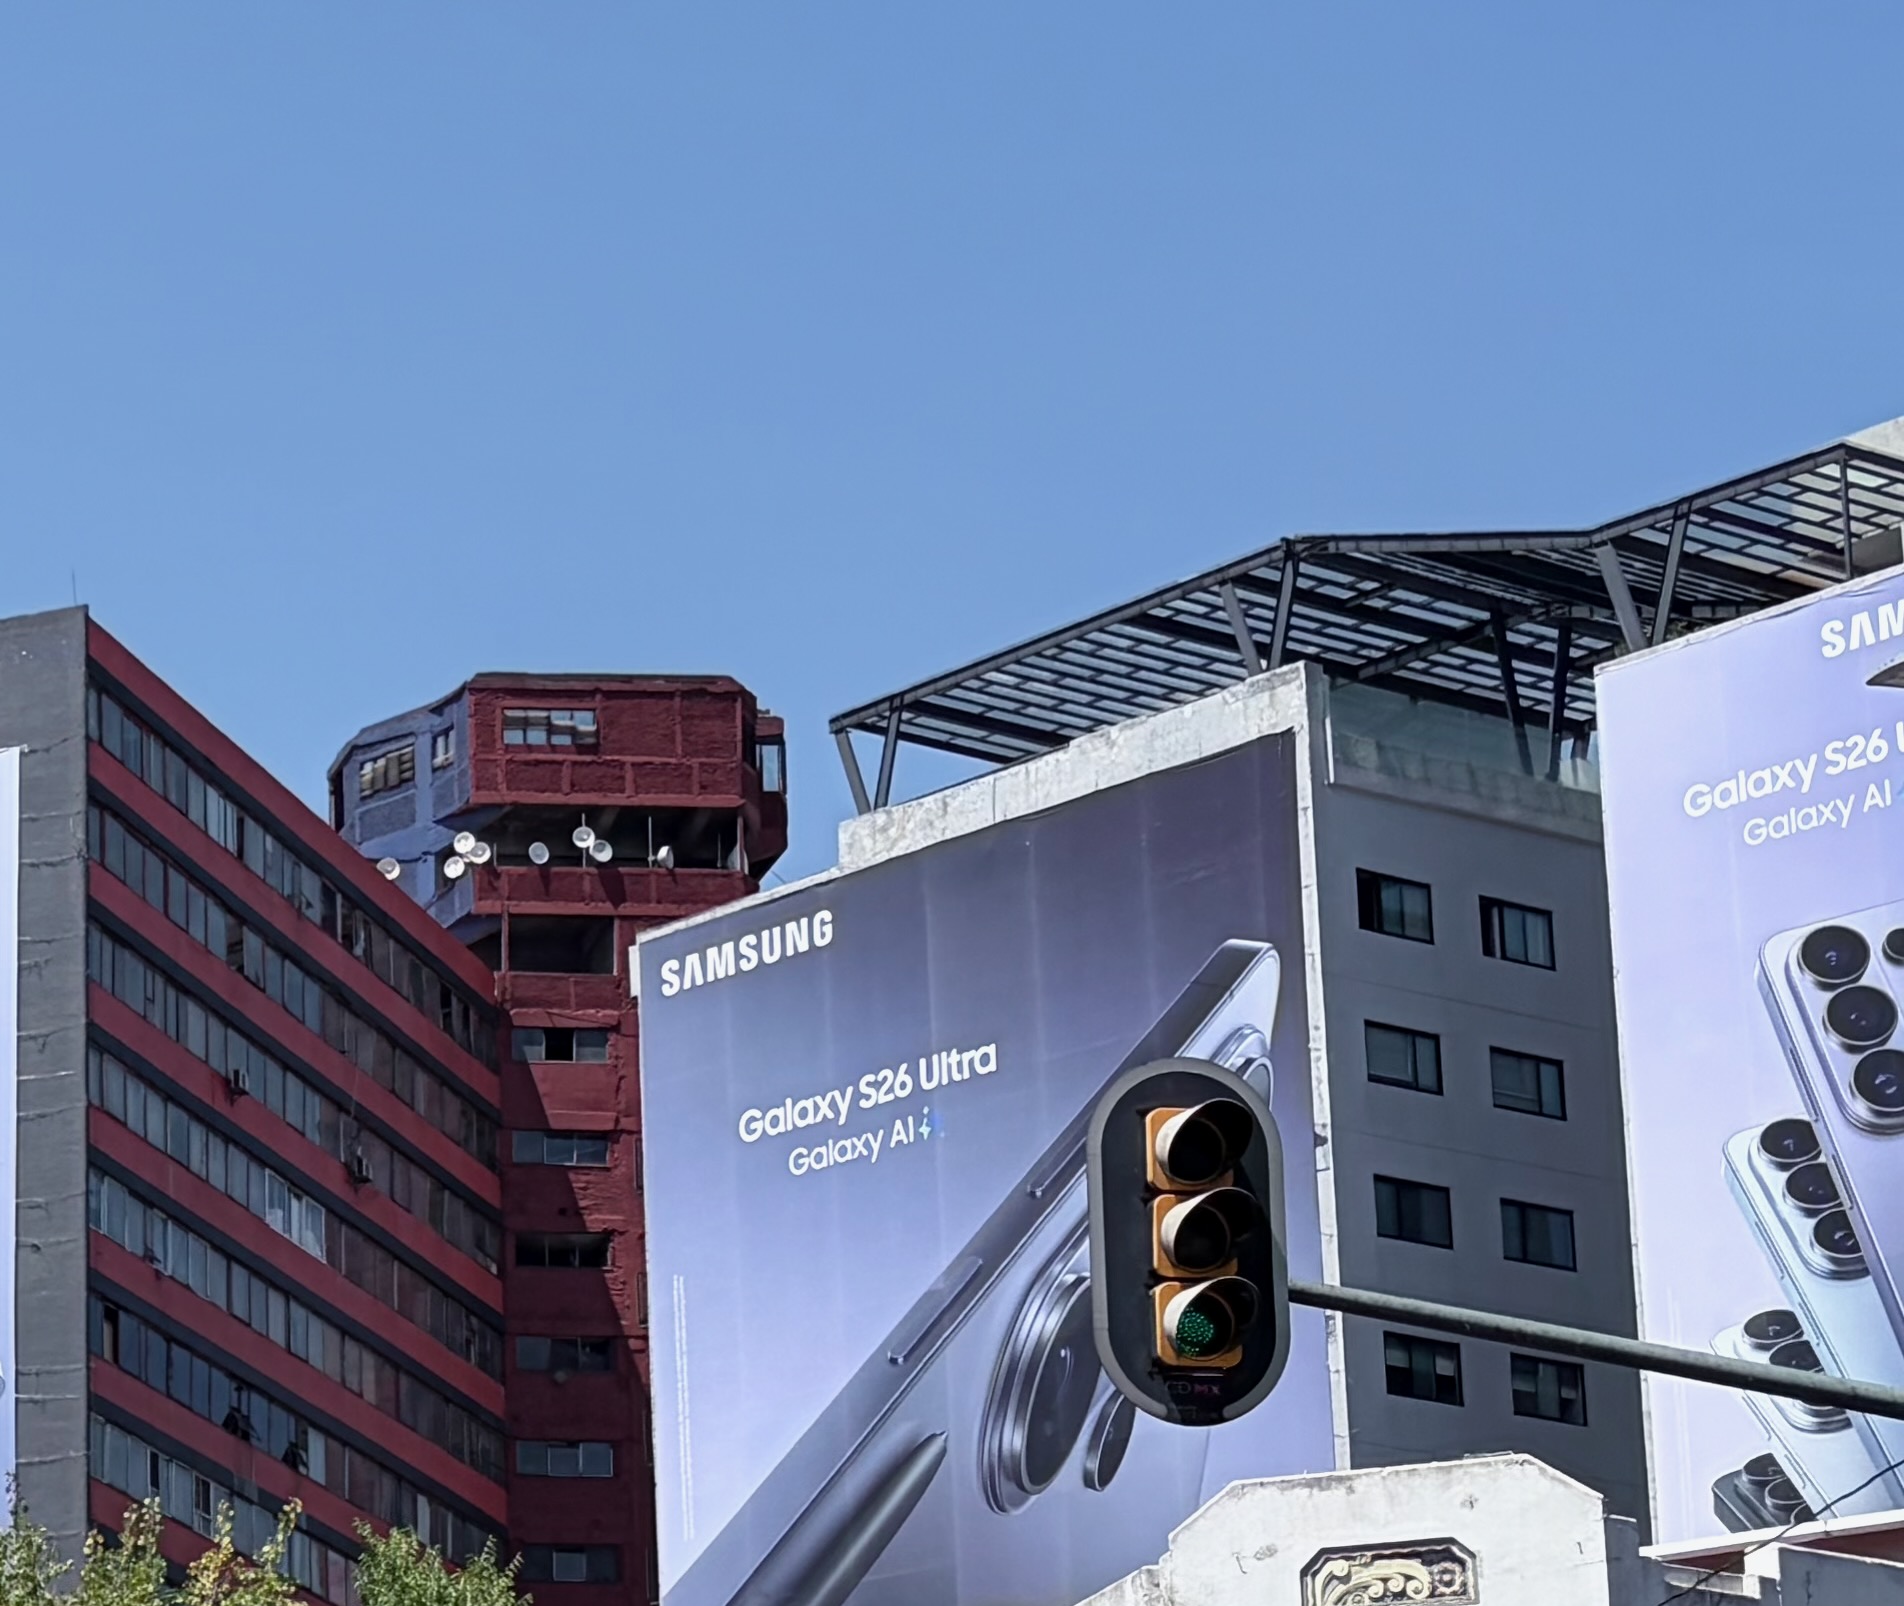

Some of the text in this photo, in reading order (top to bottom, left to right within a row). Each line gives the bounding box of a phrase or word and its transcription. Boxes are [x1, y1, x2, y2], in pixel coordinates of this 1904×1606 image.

[1682, 753, 1819, 819] Galaxy
[1824, 729, 1890, 775] S26
[1742, 779, 1893, 847] Galaxy AI
[660, 909, 834, 998] SAMSUNG
[737, 1040, 999, 1145] Galaxy S26 Ultra
[787, 1114, 915, 1177] Galaxy AI
